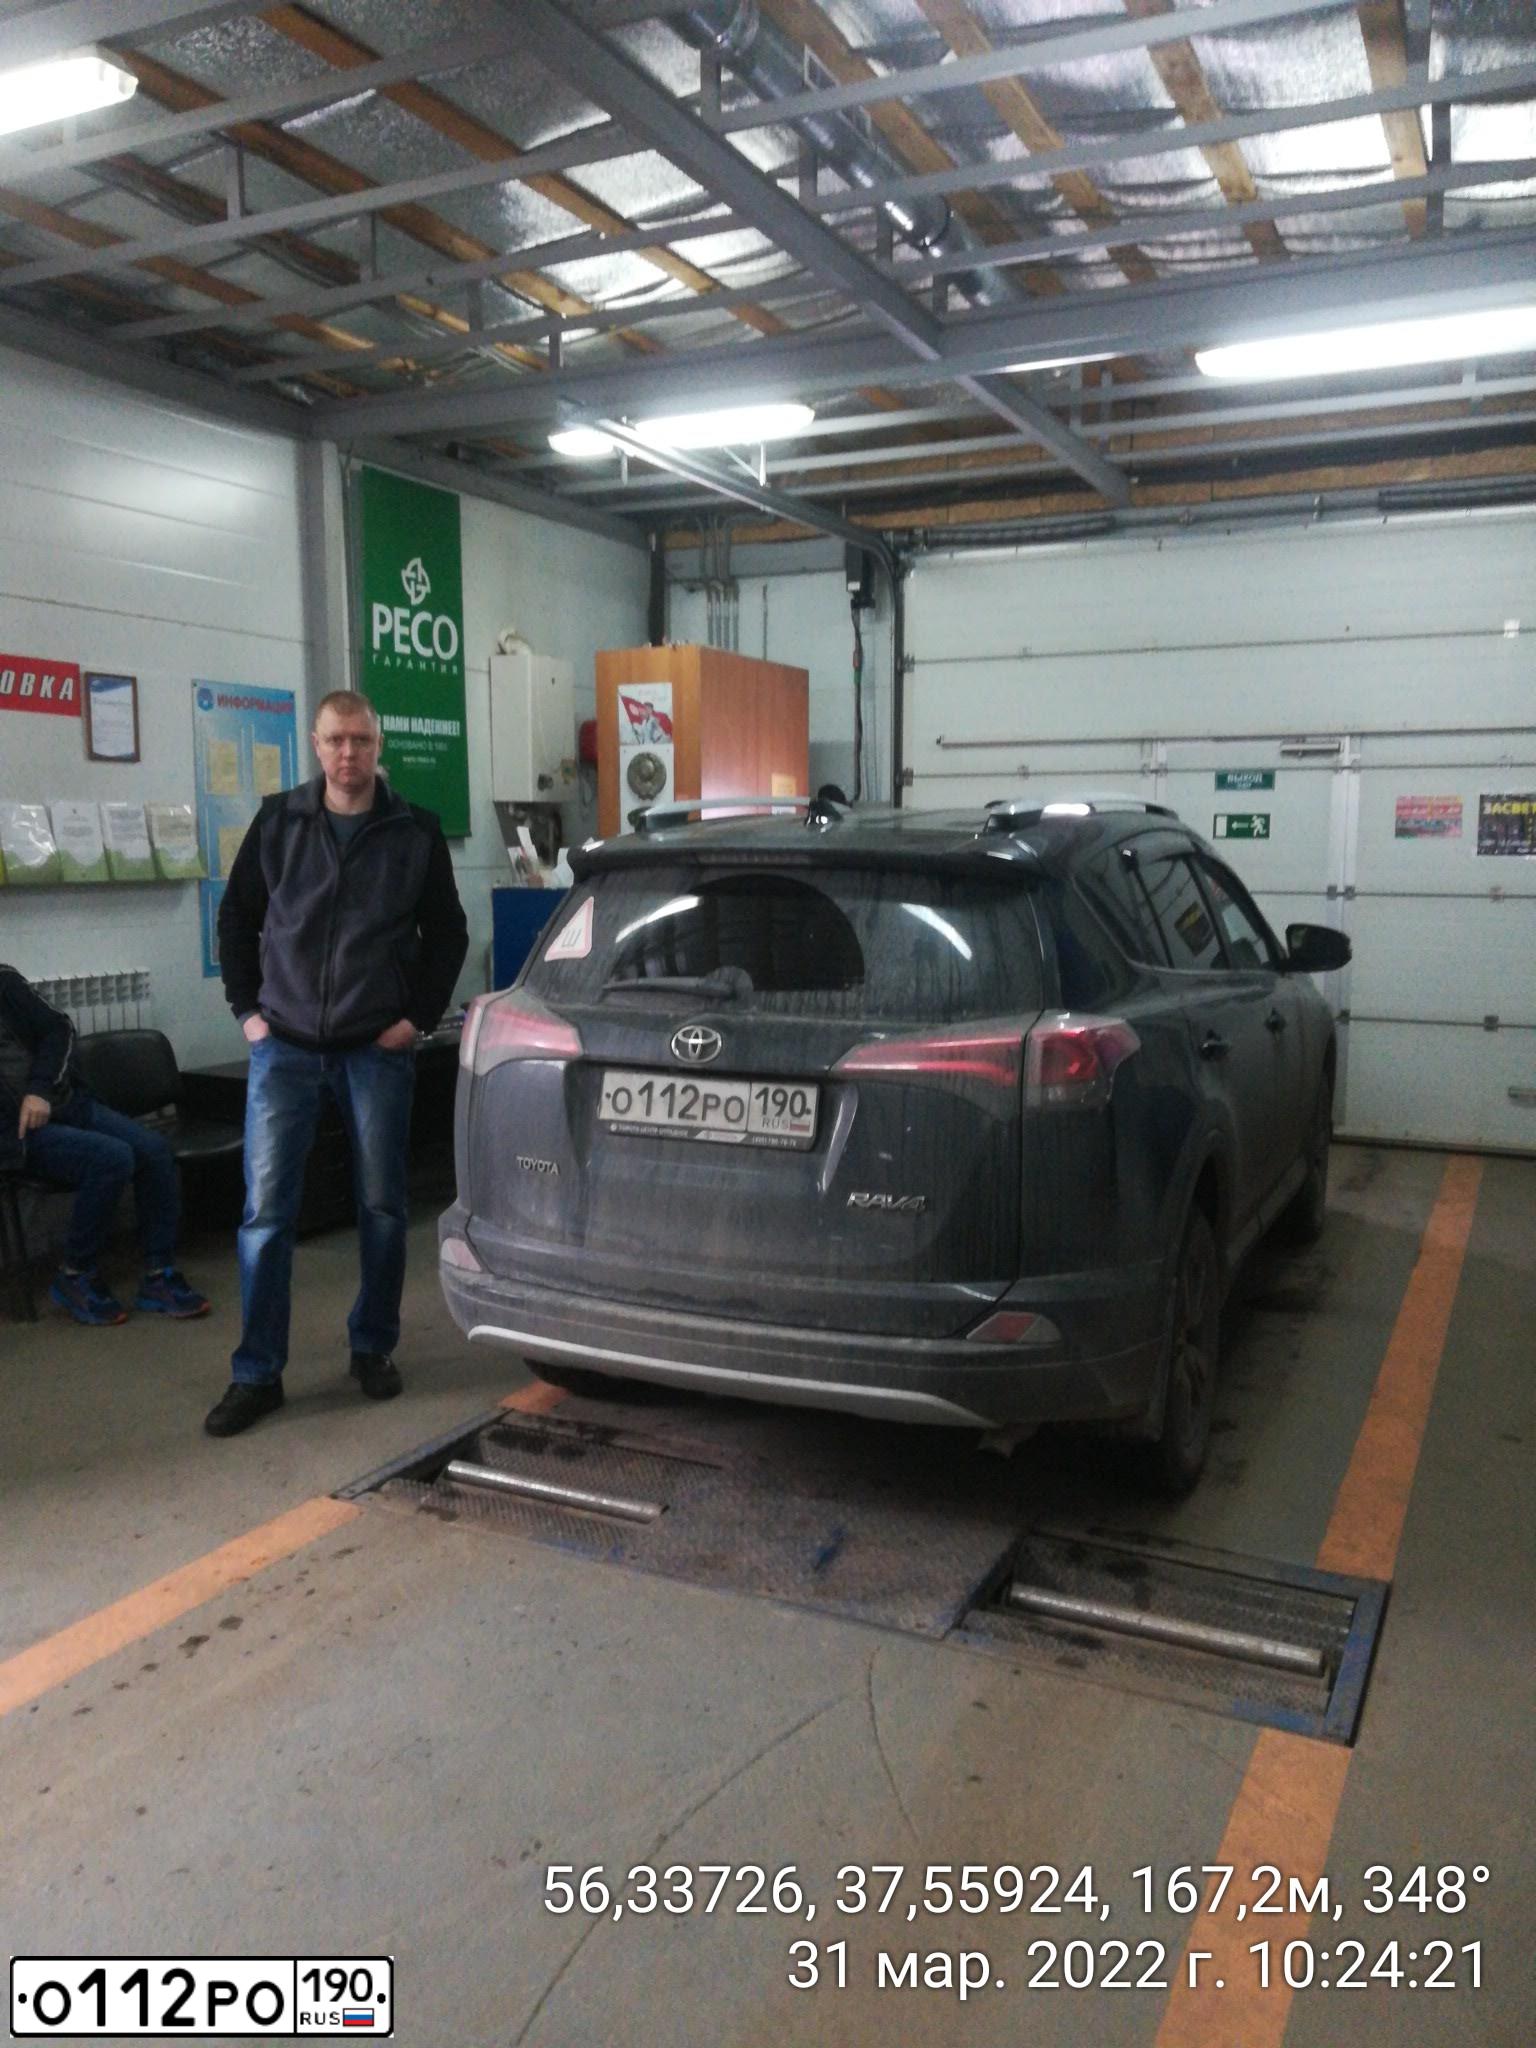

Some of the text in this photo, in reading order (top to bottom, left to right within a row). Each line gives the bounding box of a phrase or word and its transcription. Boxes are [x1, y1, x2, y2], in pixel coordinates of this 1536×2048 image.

[371, 602, 459, 661] РЕСО
[373, 653, 458, 675] ГАРАНТИЯ
[755, 1086, 808, 1118] 190
[516, 1156, 559, 1176] TOYOTA
[846, 1192, 926, 1210] RAV4
